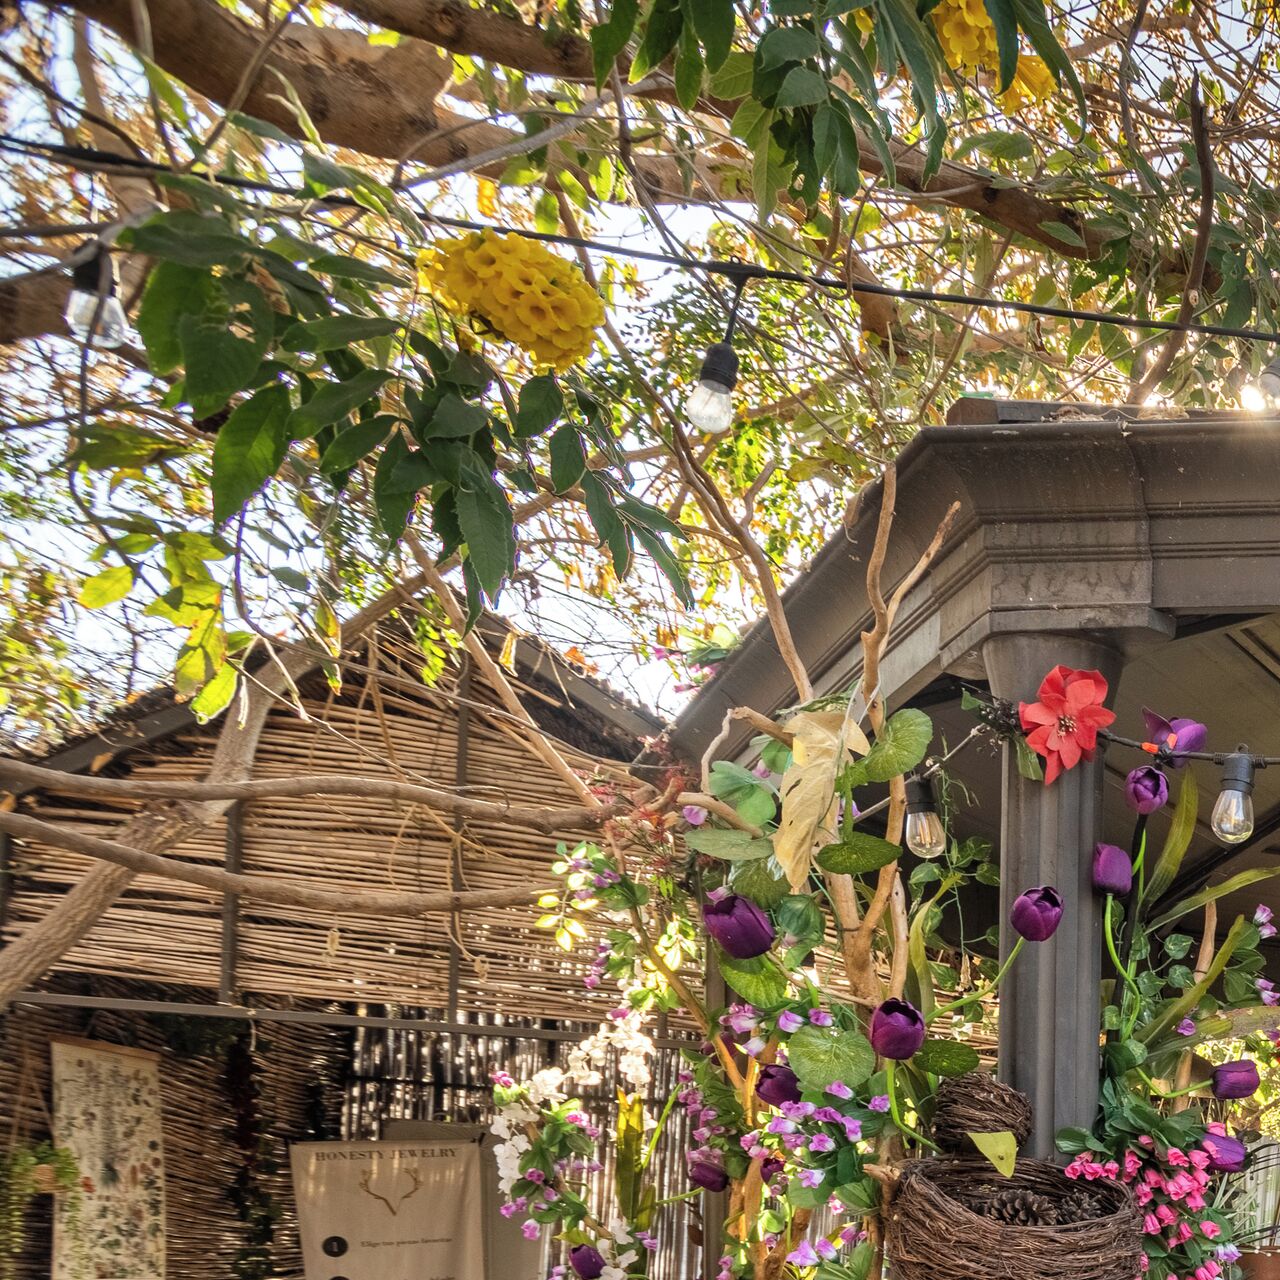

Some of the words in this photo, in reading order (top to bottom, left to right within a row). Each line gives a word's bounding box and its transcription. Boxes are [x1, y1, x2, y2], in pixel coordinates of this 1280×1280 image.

[315, 1149, 384, 1161] HONESTY
[389, 1148, 459, 1160] JEWELRY
[332, 1241, 339, 1252] 1
